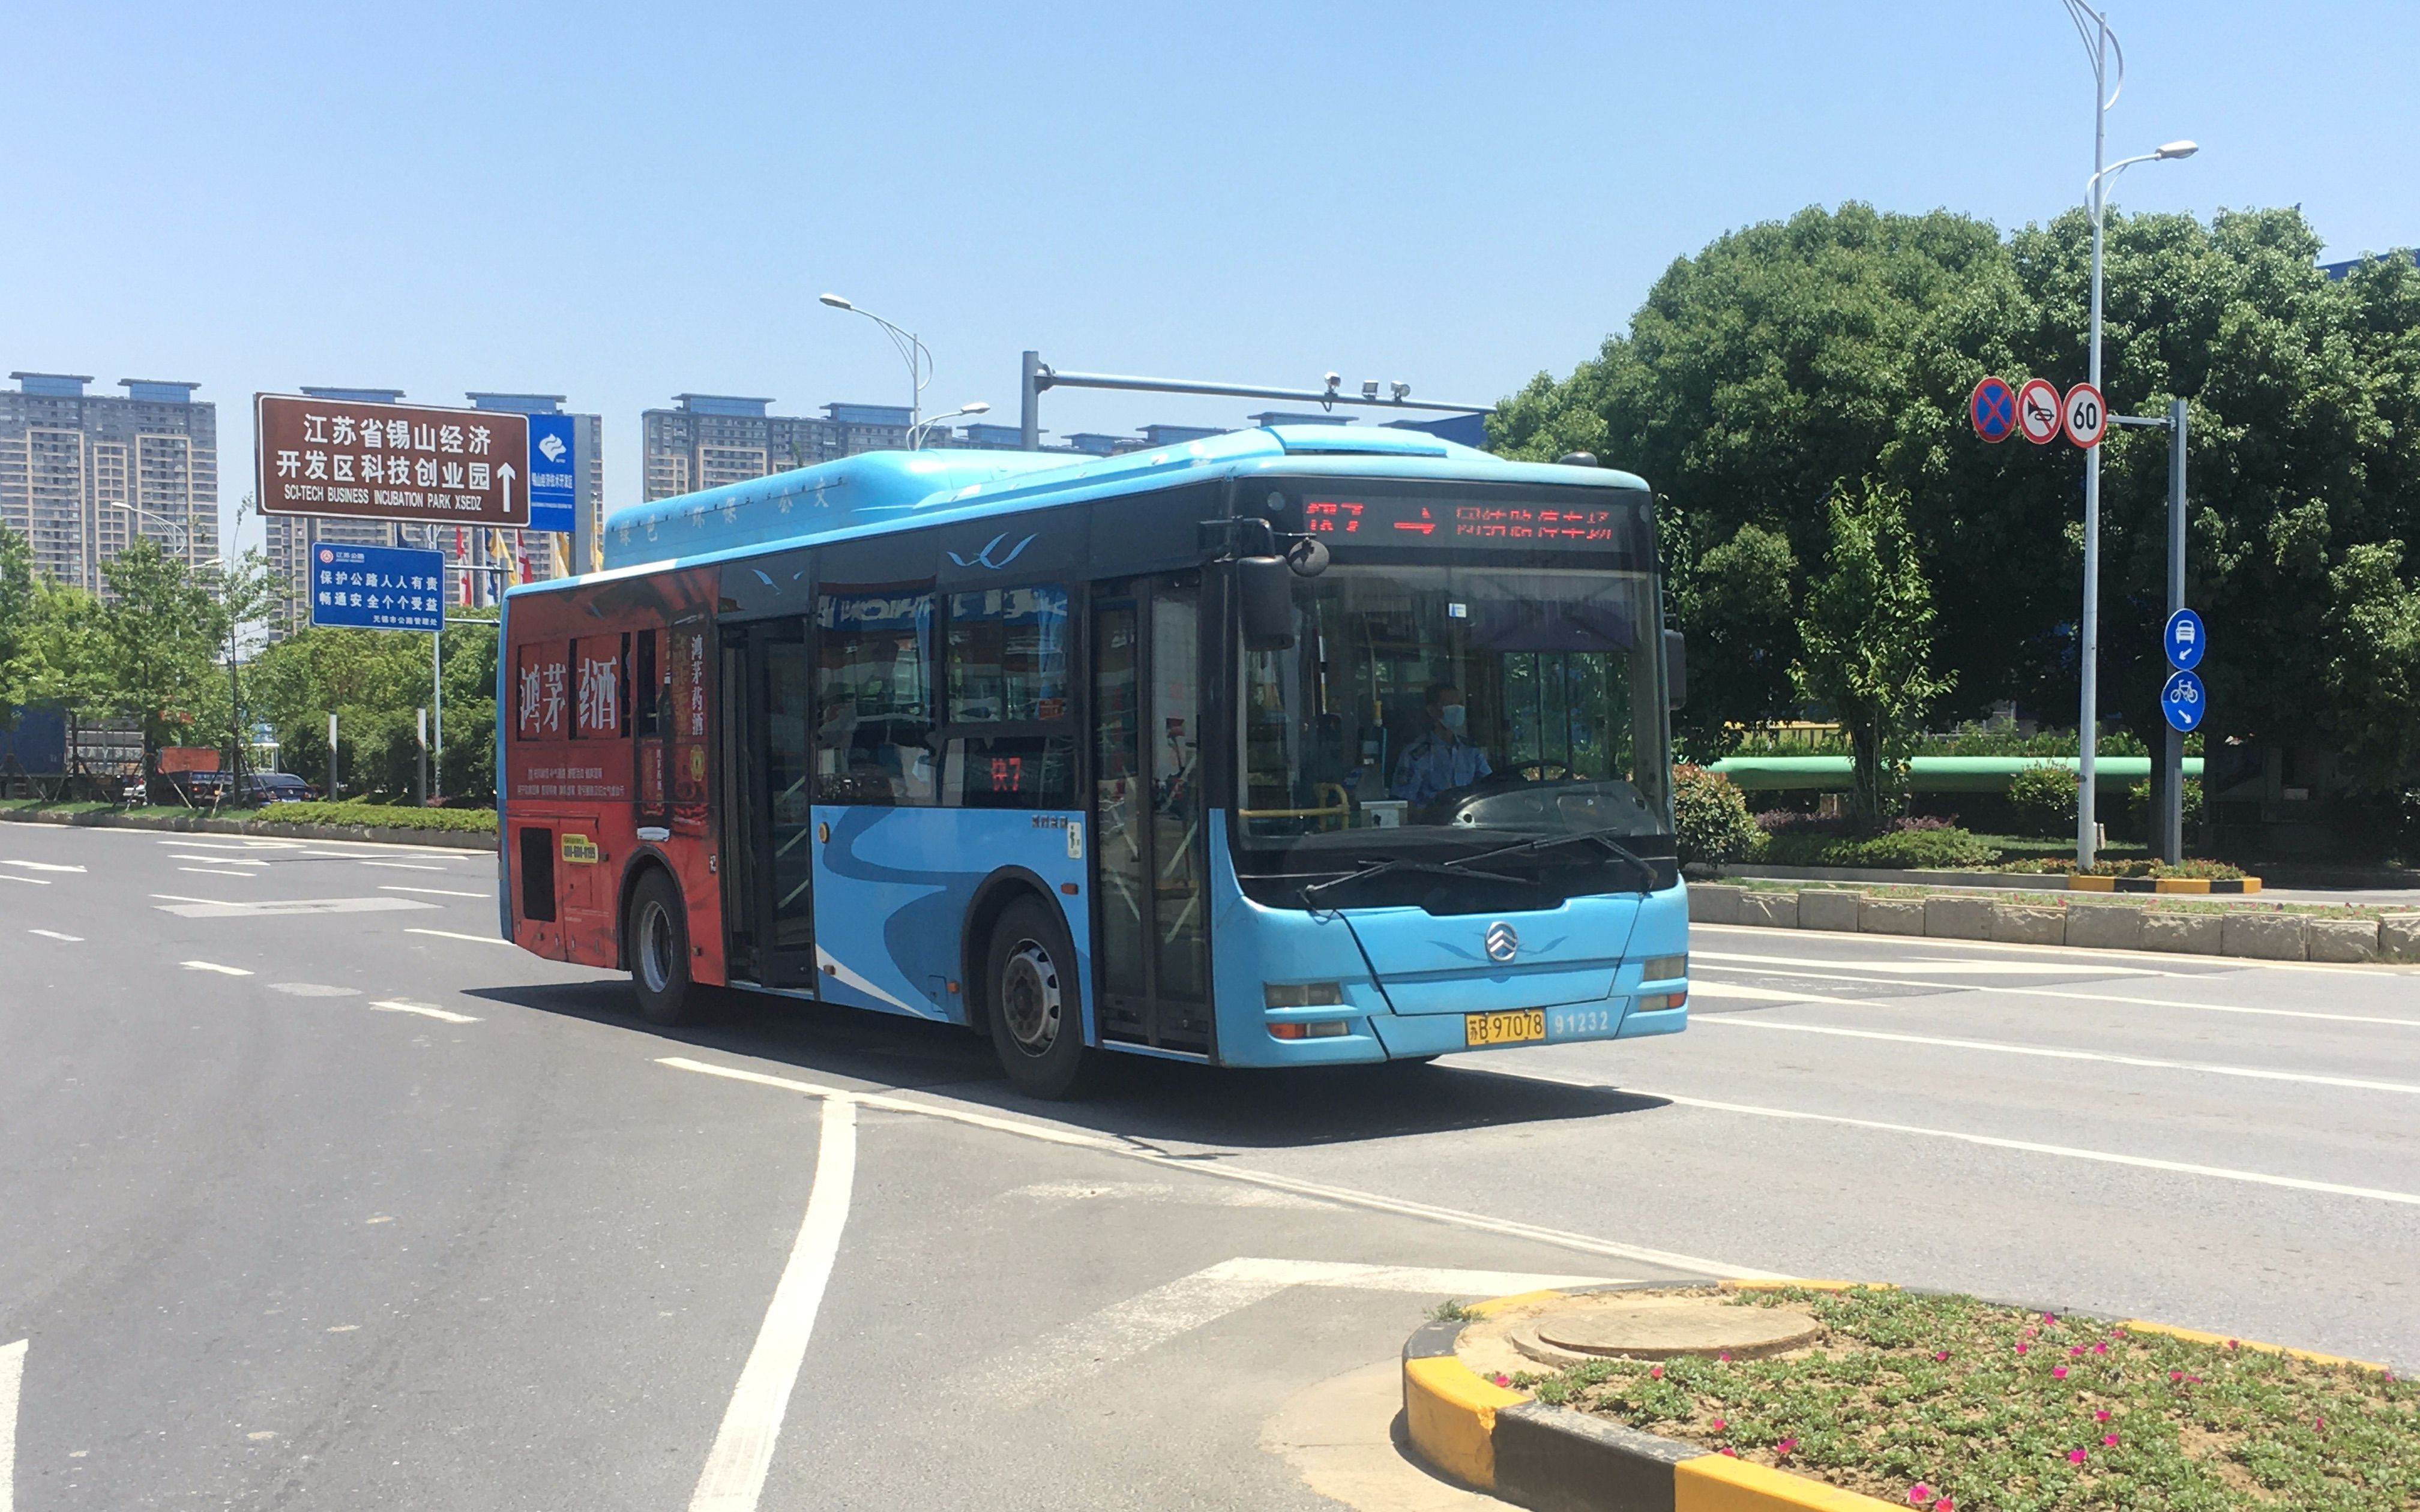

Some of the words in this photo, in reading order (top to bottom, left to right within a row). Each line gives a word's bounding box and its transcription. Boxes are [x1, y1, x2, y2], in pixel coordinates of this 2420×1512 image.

[2074, 402, 2096, 430] 60
[304, 413, 492, 455] 江苏省锡山经济
[276, 450, 490, 490] 开发区科技创业园
[284, 484, 324, 502] SCI-TECH
[328, 486, 370, 504] BUSINESS
[374, 490, 424, 508] INCUBATION
[427, 493, 451, 509] PARK
[455, 494, 482, 511] XSEDZ
[321, 570, 438, 591] 保护公路人人有责
[319, 591, 438, 612] 畅通安全个个受益
[691, 634, 703, 736] 鸿茅药酒
[1555, 1010, 1608, 1034] 91232
